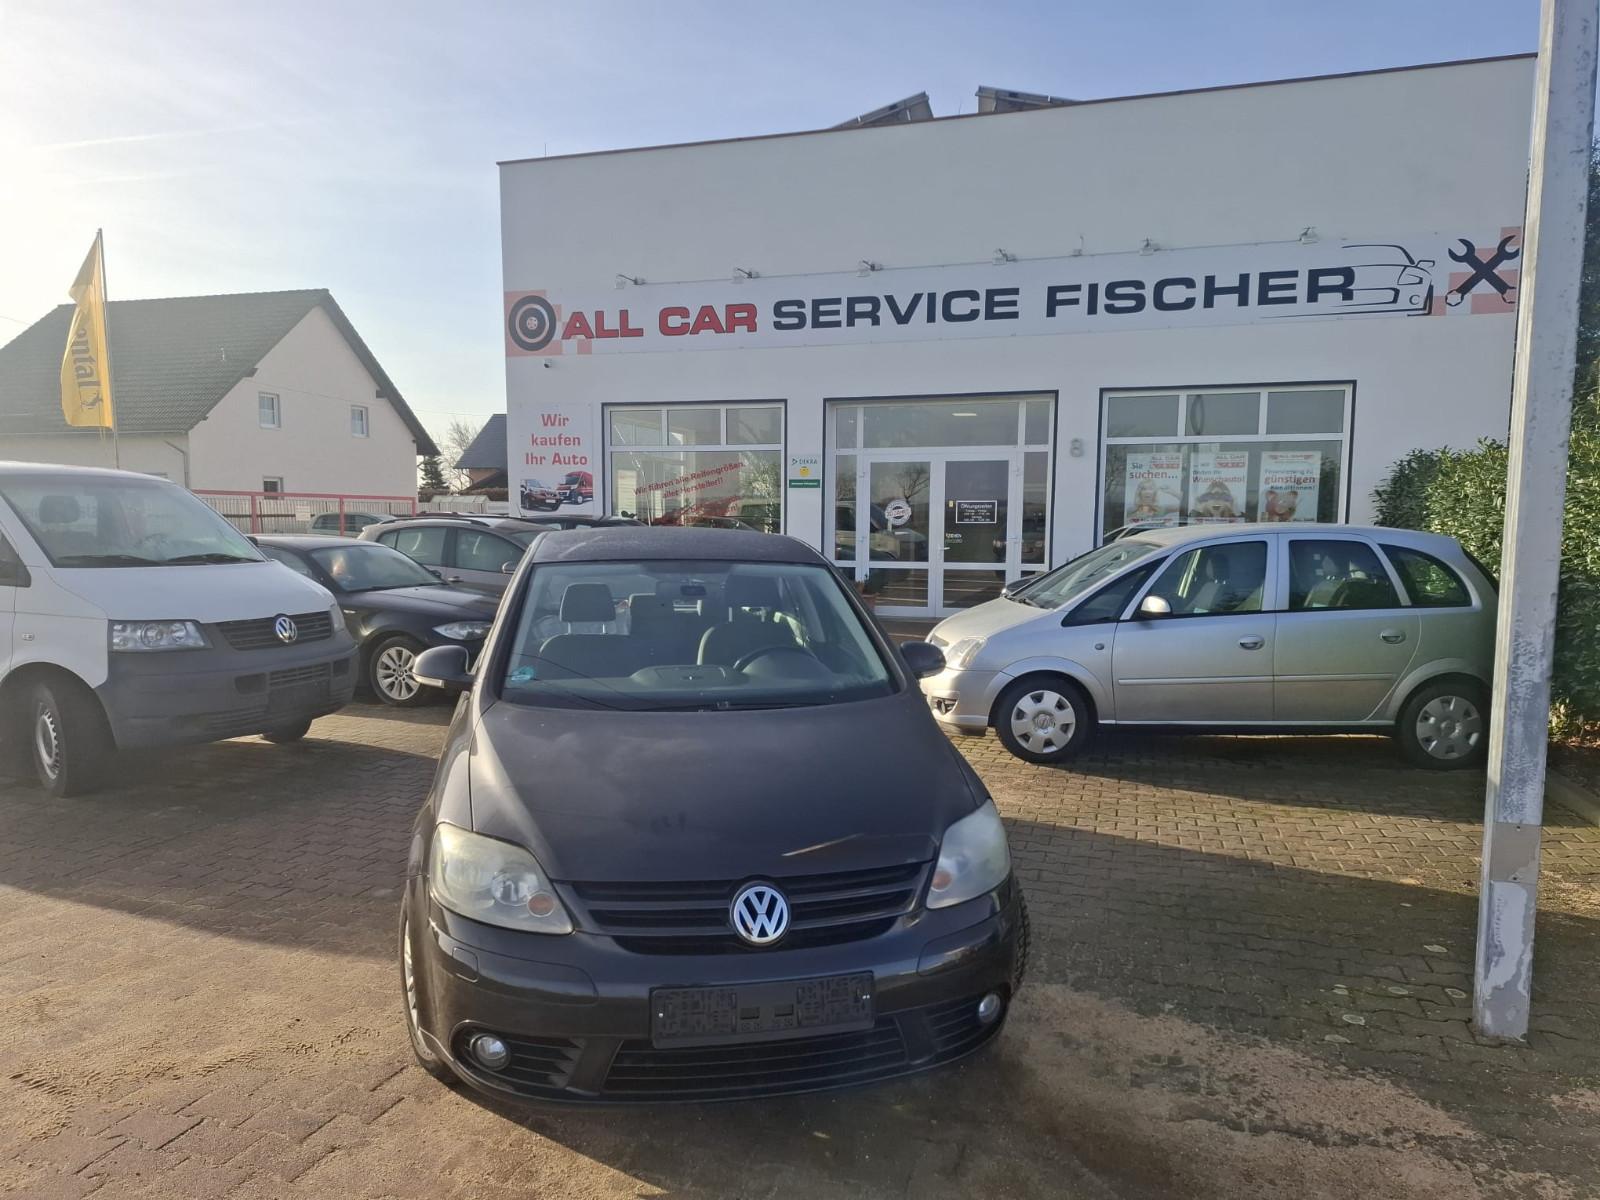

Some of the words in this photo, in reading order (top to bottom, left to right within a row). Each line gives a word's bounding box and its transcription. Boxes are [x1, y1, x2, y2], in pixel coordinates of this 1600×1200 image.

[561, 310, 644, 340] ALL
[658, 303, 758, 336] CAR
[772, 287, 1020, 331] SERVICE
[1045, 265, 1356, 319] FISCHER
[541, 412, 570, 427] Wir
[531, 432, 581, 447] kaufen
[525, 452, 547, 465] Ihr
[551, 452, 589, 466] Auto
